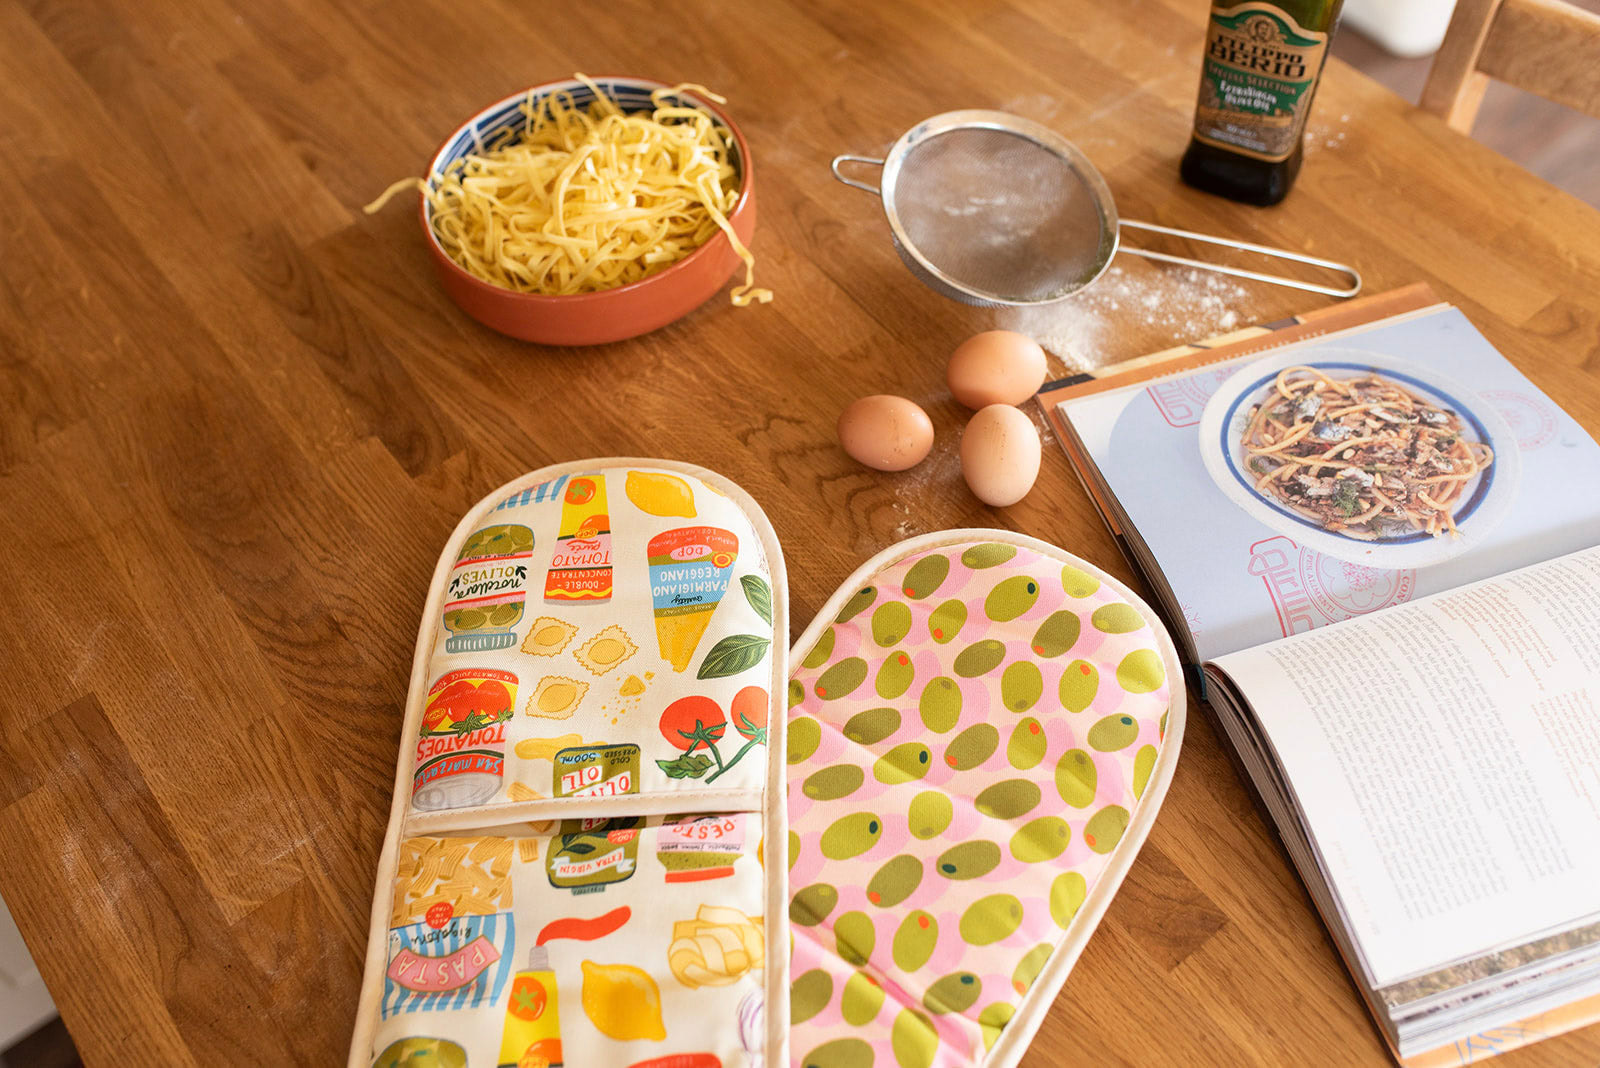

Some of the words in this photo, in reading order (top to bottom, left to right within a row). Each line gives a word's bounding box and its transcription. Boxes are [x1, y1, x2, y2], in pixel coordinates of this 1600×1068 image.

[1218, 35, 1302, 64] FILIPPO
[1211, 42, 1306, 78] BERIO
[552, 551, 610, 567] TOMATO
[678, 546, 703, 557] DOP
[462, 566, 515, 584] OLIVES
[551, 569, 612, 579] CONCENTRATE
[660, 567, 720, 581] REGGIANO
[565, 581, 599, 589] DOUBLE
[653, 580, 727, 596] PARMIGIANO
[1308, 573, 1335, 614] ALIMENTI
[416, 725, 505, 760] TOMATOES
[604, 748, 636, 758] PRESSED
[610, 756, 630, 765] COLD
[477, 758, 501, 773] San
[563, 767, 599, 790] OIL
[576, 776, 629, 797] OLI
[596, 851, 622, 868] EXTRA
[559, 864, 592, 874] VIRGIN
[398, 946, 486, 984] PASTA
